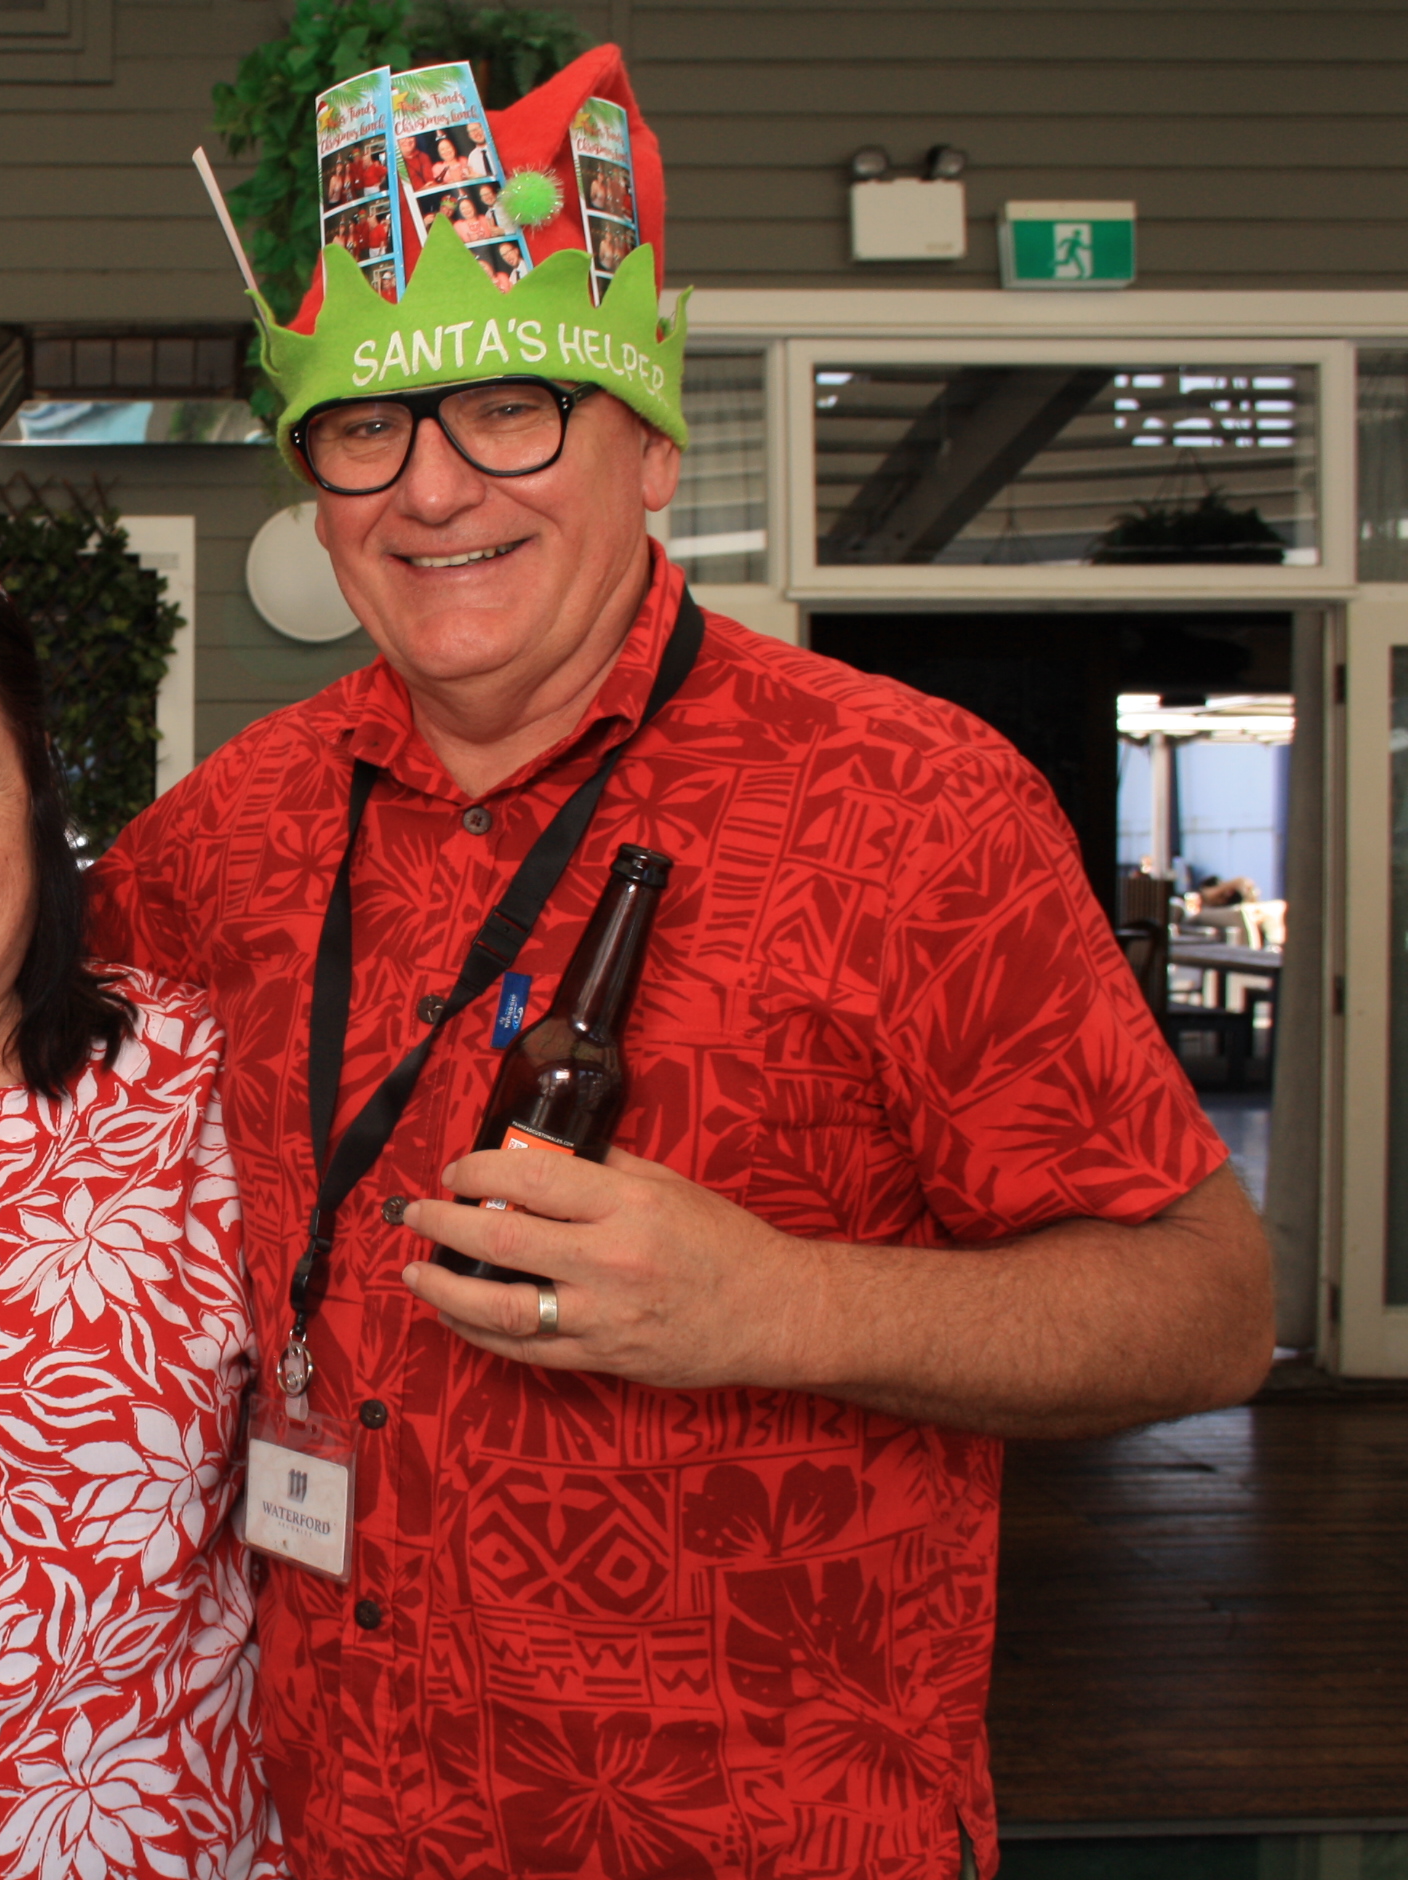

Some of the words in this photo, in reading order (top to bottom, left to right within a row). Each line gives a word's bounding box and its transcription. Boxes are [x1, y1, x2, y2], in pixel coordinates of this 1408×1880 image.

[352, 318, 548, 388] SANTA'S
[557, 322, 669, 408] HELPER
[262, 1500, 331, 1536] WATERFORD
